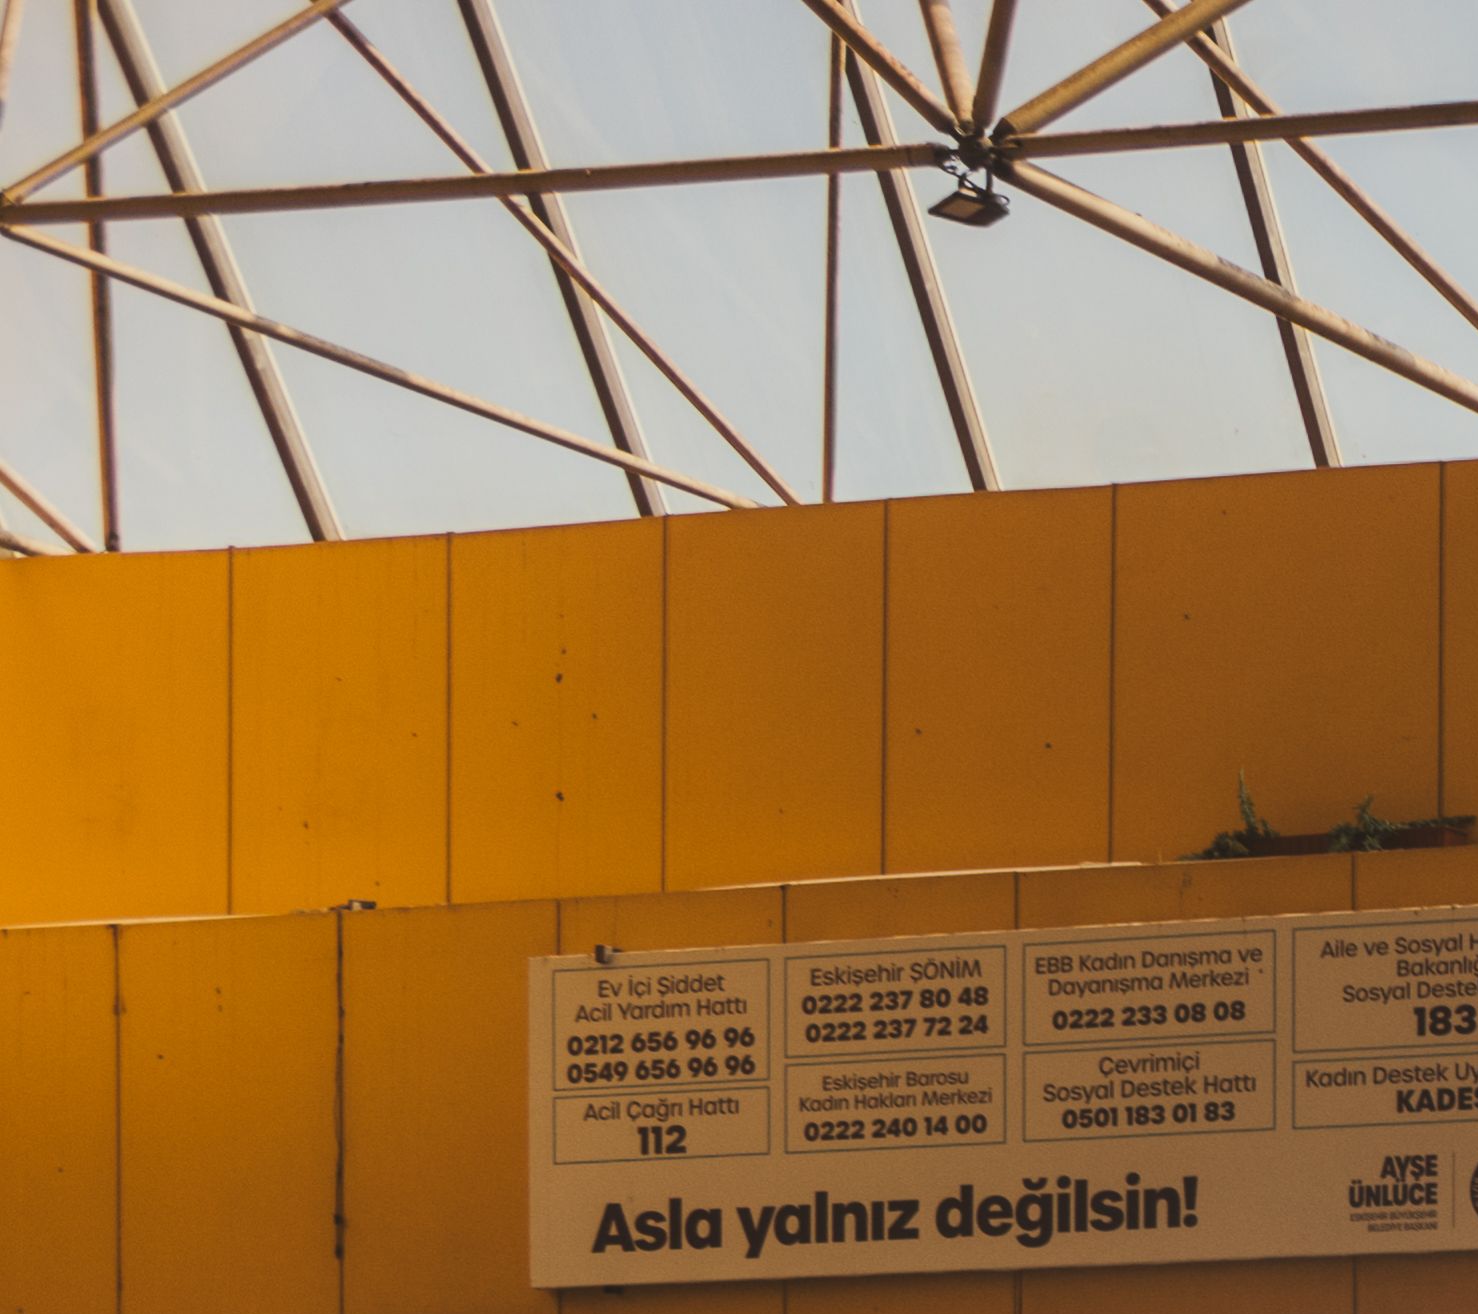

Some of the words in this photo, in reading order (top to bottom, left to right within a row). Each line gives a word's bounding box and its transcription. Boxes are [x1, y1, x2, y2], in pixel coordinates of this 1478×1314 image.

[1035, 956, 1073, 974] EBB
[1079, 952, 1136, 972] Kadın
[1141, 948, 1232, 968] Danışma
[1238, 947, 1263, 963] ve
[1320, 939, 1358, 959] Aile
[1363, 940, 1389, 956] ve
[1395, 934, 1464, 957] Sosyal
[810, 963, 904, 987] Eskişehir
[910, 956, 982, 983] ŞÖNİM
[1048, 975, 1164, 998] Dayanışma
[1168, 969, 1250, 990] Merkezi
[598, 979, 622, 998] Ev
[629, 975, 651, 999] İçi
[657, 974, 725, 997] Şiddet
[802, 993, 863, 1015] 0222
[869, 990, 913, 1011] 237
[920, 988, 951, 1009] 80
[958, 986, 988, 1006] 48
[1342, 983, 1411, 1005] Sosyal
[575, 1004, 612, 1022] Acil
[617, 1000, 691, 1020] Yardım
[697, 998, 747, 1016] Hattı
[1052, 1008, 1115, 1030] 0222
[1121, 1004, 1168, 1026] 233
[1174, 1002, 1207, 1023] 08
[1213, 1000, 1246, 1021] 08
[1413, 1004, 1478, 1037] 183
[567, 1033, 624, 1056] 0212
[631, 1031, 678, 1053] 656
[685, 1029, 717, 1050] 96
[723, 1026, 756, 1048] 96
[806, 1021, 866, 1043] 0222
[873, 1018, 917, 1039] 237
[923, 1017, 952, 1037] 72
[958, 1015, 988, 1035] 24
[567, 1061, 629, 1084] 0549
[634, 1058, 681, 1081] 656
[687, 1056, 718, 1077] 96
[724, 1054, 756, 1076] 96
[1099, 1051, 1200, 1076] Çevrimiçi
[1305, 1068, 1367, 1088] Kadın
[1372, 1063, 1449, 1085] Destek
[822, 1072, 900, 1092] Eskişehir
[906, 1070, 969, 1088] Barosu
[1043, 1081, 1115, 1104] Sosyal
[1120, 1076, 1198, 1099] Destek
[1203, 1074, 1257, 1094] Hattı
[583, 1102, 620, 1121] Acil
[627, 1099, 683, 1122] Çağrı
[689, 1097, 740, 1115] Hattı
[799, 1096, 849, 1113] Kadın
[922, 1087, 992, 1106] Merkezi
[804, 1120, 865, 1142] 0222
[872, 1117, 917, 1138] 240
[924, 1116, 948, 1136] 14
[955, 1114, 987, 1134] 00
[1061, 1107, 1119, 1129] 0501
[1125, 1104, 1165, 1126] 183
[1172, 1103, 1198, 1124] 01
[1204, 1101, 1236, 1122] 83
[637, 1124, 687, 1155] 112
[1380, 1154, 1438, 1181] AYŞE
[1349, 1179, 1439, 1208] ÜNLÜCE
[592, 1198, 723, 1254] Asla
[736, 1191, 920, 1259] yalnız
[935, 1172, 1199, 1249] değilsin!
